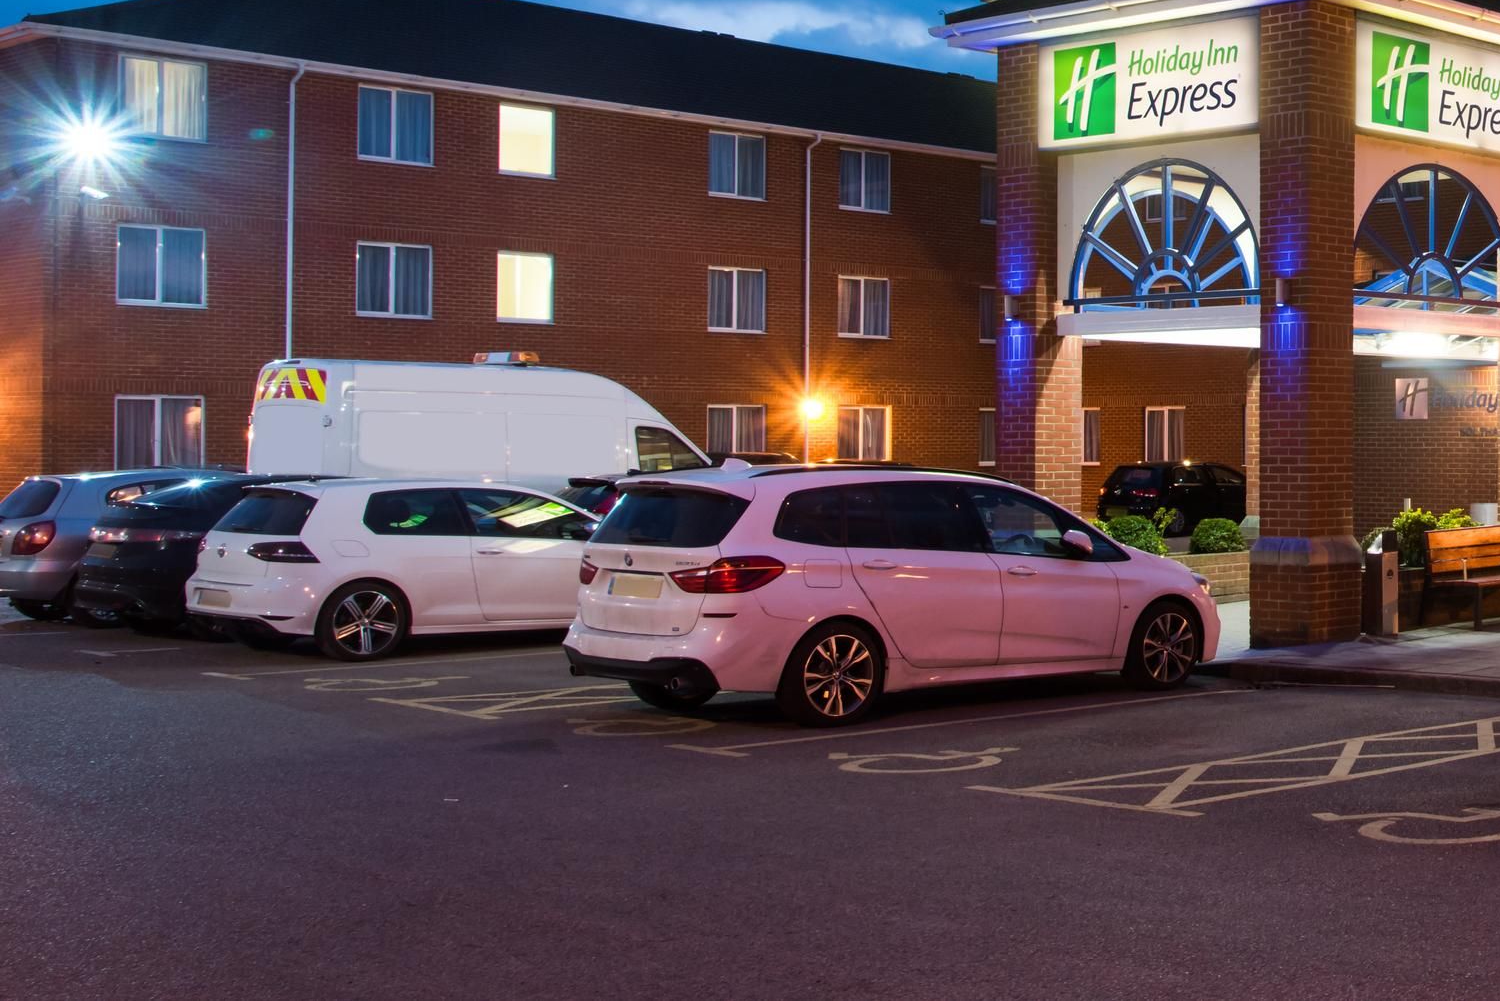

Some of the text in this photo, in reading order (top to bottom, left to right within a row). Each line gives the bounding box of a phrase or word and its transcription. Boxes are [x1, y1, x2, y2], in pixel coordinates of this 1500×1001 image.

[1128, 39, 1239, 77] Holiday Inn
[1127, 79, 1239, 127] Express
